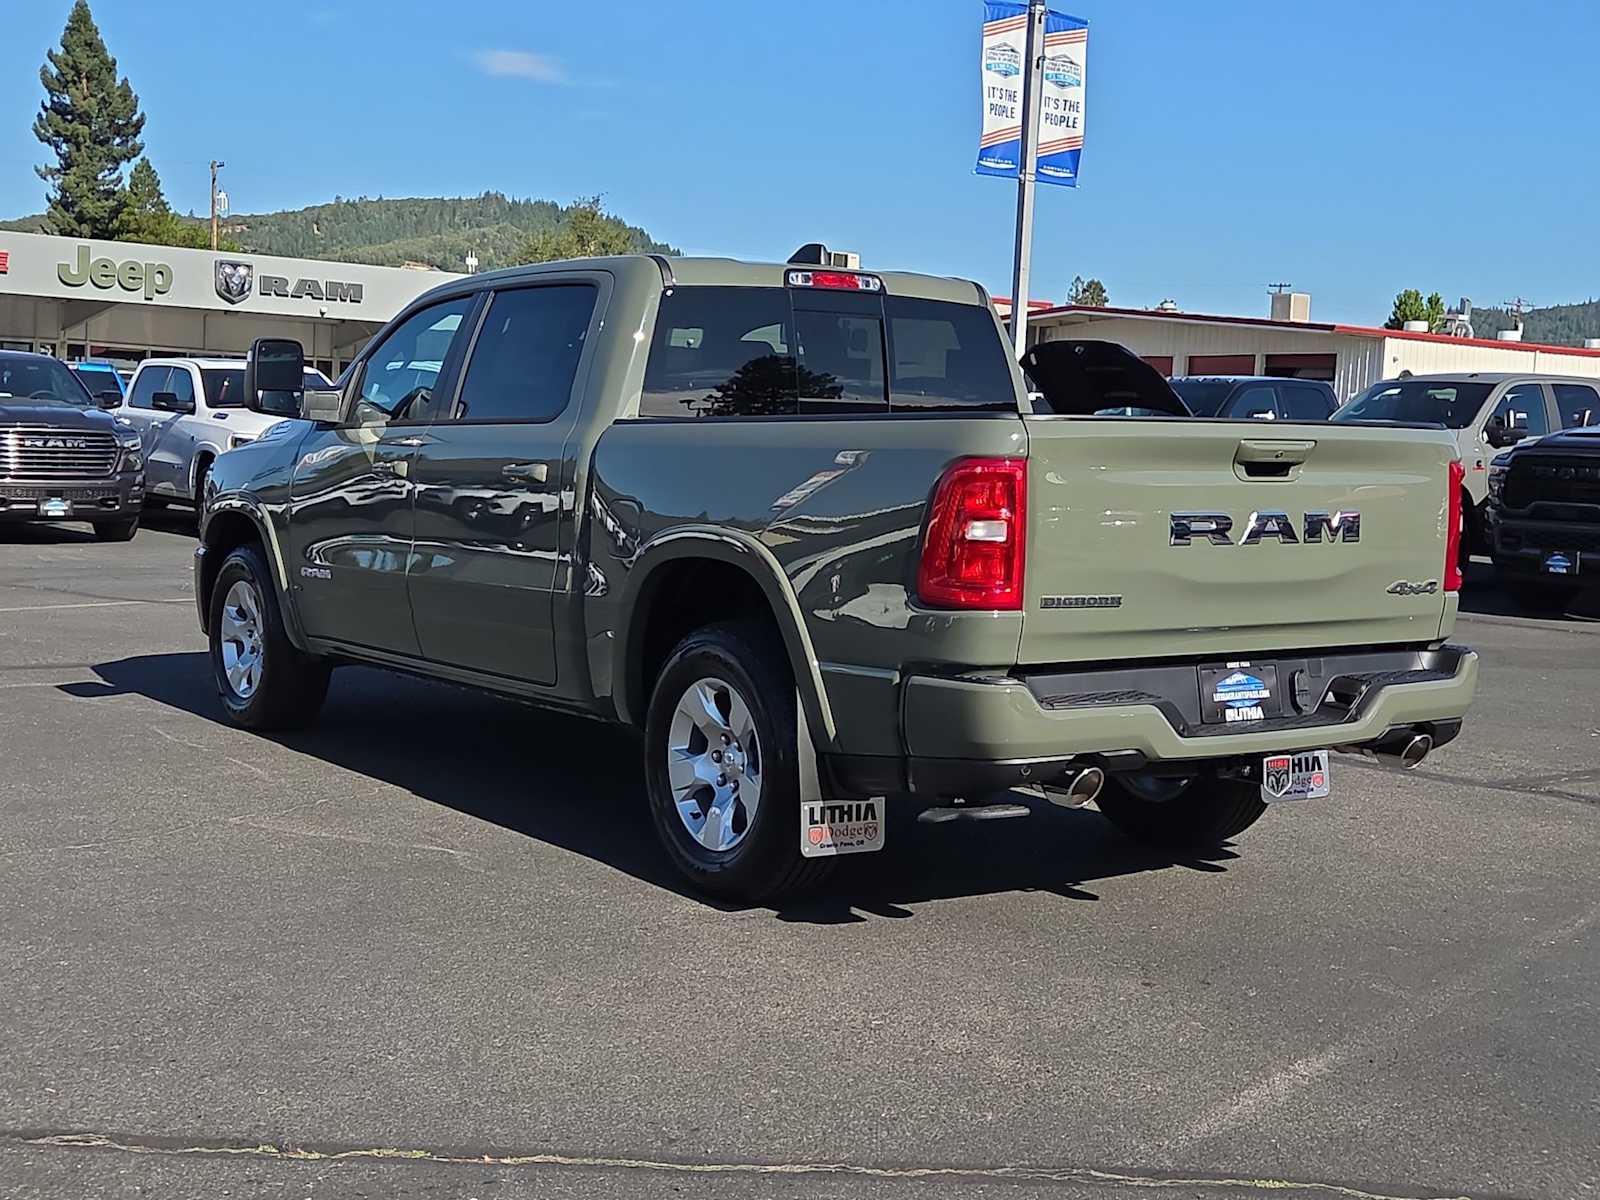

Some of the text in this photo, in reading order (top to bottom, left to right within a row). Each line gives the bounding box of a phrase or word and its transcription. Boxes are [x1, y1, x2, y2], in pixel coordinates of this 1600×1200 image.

[988, 86, 1017, 103] IT'S THE
[989, 103, 1016, 119] PEOPLE
[1044, 96, 1080, 113] IT'S THE
[1044, 112, 1079, 129] PEOPLE
[57, 245, 174, 301] Jeep
[259, 274, 364, 304] RAM
[24, 438, 87, 448] RAM
[1169, 511, 1362, 547] RAM
[1386, 579, 1439, 597] 4x4
[1040, 594, 1122, 609] BIGHORN
[809, 803, 877, 825] LITHIA
